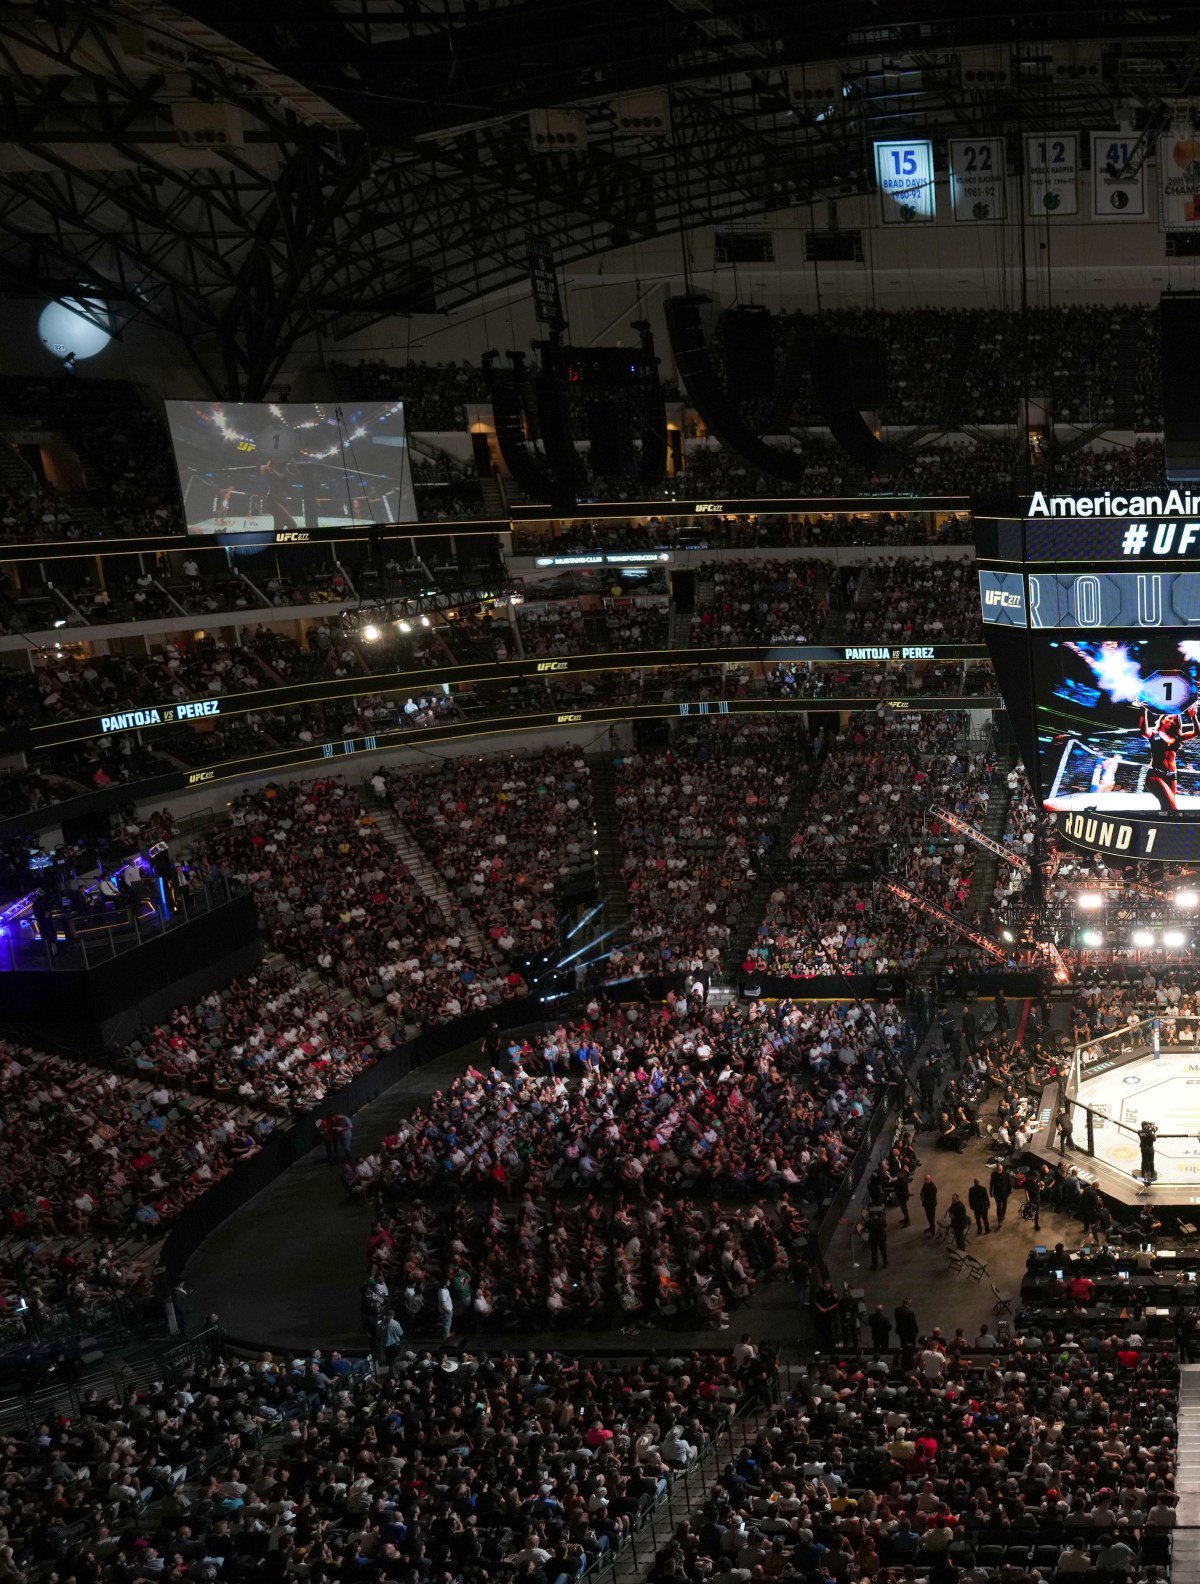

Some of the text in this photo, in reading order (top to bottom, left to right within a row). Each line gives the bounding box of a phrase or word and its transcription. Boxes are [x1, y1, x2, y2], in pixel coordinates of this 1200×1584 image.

[965, 145, 992, 171] 22
[1039, 141, 1066, 163] 12
[1106, 143, 1128, 164] 41
[891, 150, 917, 176] 15
[884, 178, 927, 188] BRAD DAVIS
[1168, 177, 1184, 186] 2011
[891, 189, 921, 200] 1980-92
[964, 187, 995, 197] 1981-92
[845, 647, 934, 660] PANTOJA VS PEREZ
[1162, 682, 1173, 700] 1
[101, 700, 220, 732] PANTOJA VS PEREZ
[1143, 828, 1158, 853] 1
